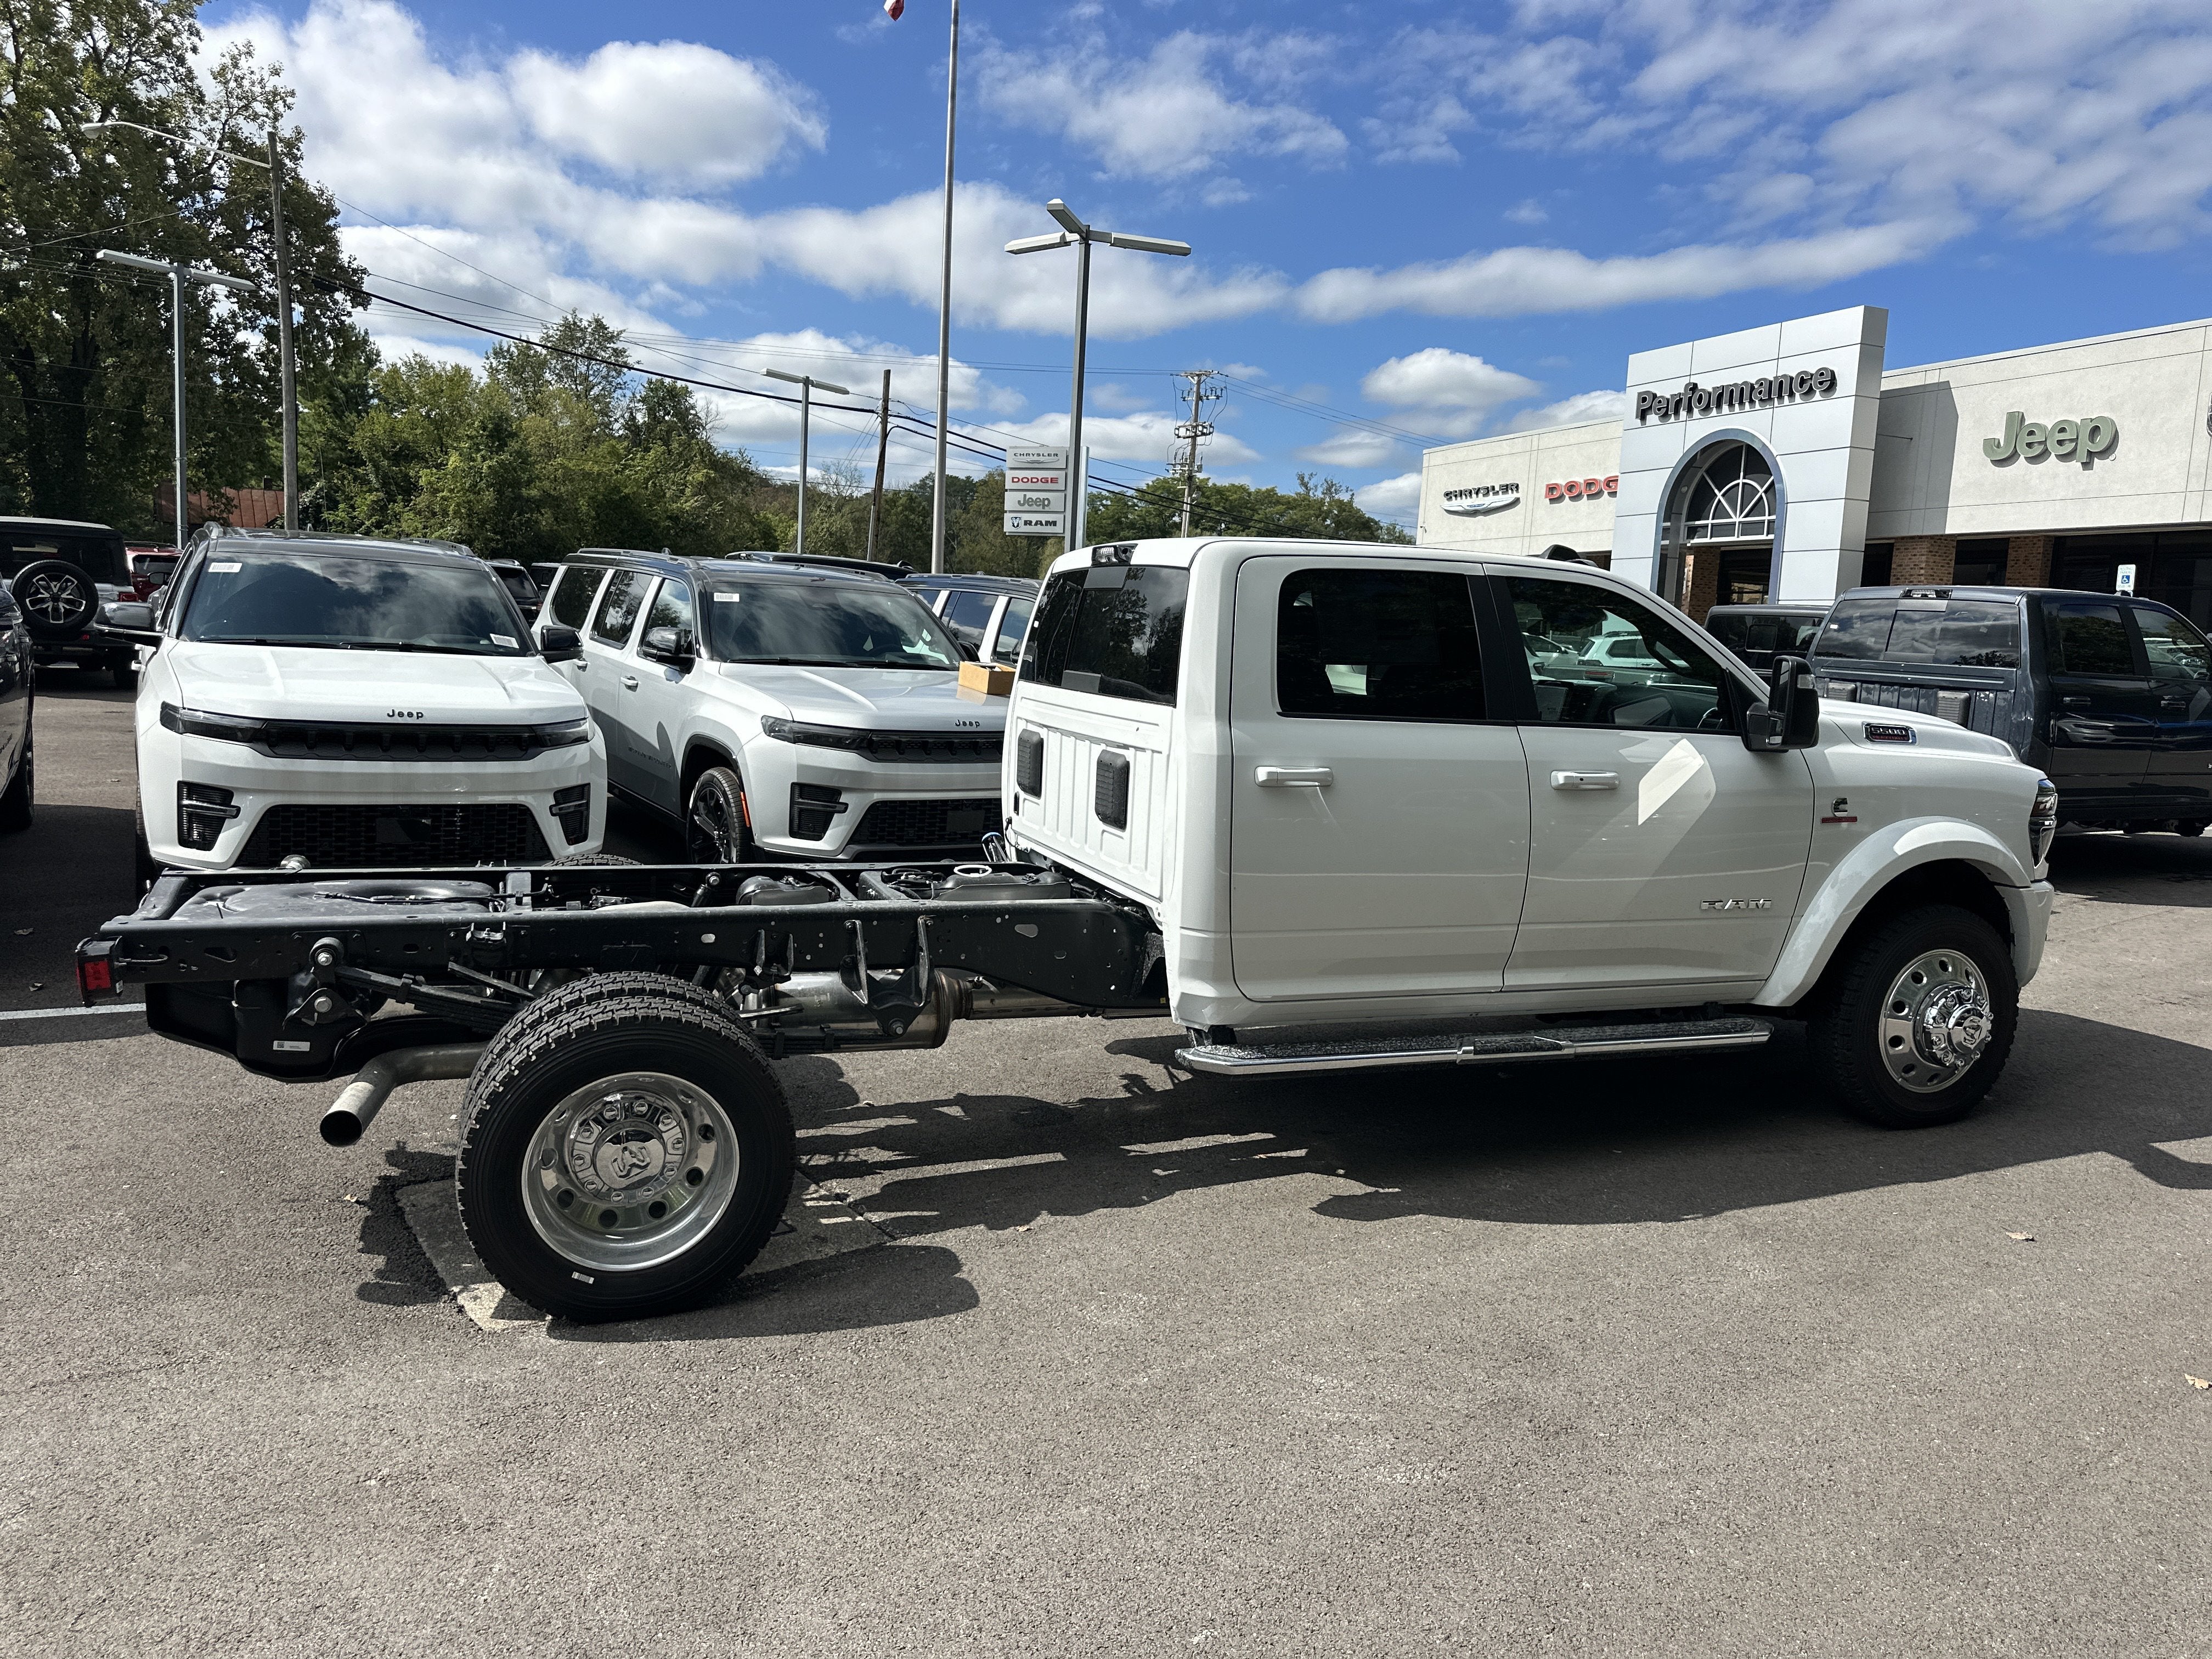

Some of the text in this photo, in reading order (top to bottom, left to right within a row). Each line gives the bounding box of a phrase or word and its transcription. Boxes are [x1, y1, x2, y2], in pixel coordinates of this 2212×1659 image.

[1635, 366, 1837, 420] Performance
[1982, 411, 2117, 463] Jeep
[1443, 483, 1520, 499] CHRYSLER
[1017, 494, 1051, 510] Jeep
[387, 709, 424, 720] Jeep
[955, 719, 980, 728] Jeep
[1700, 898, 1772, 910] RAM
